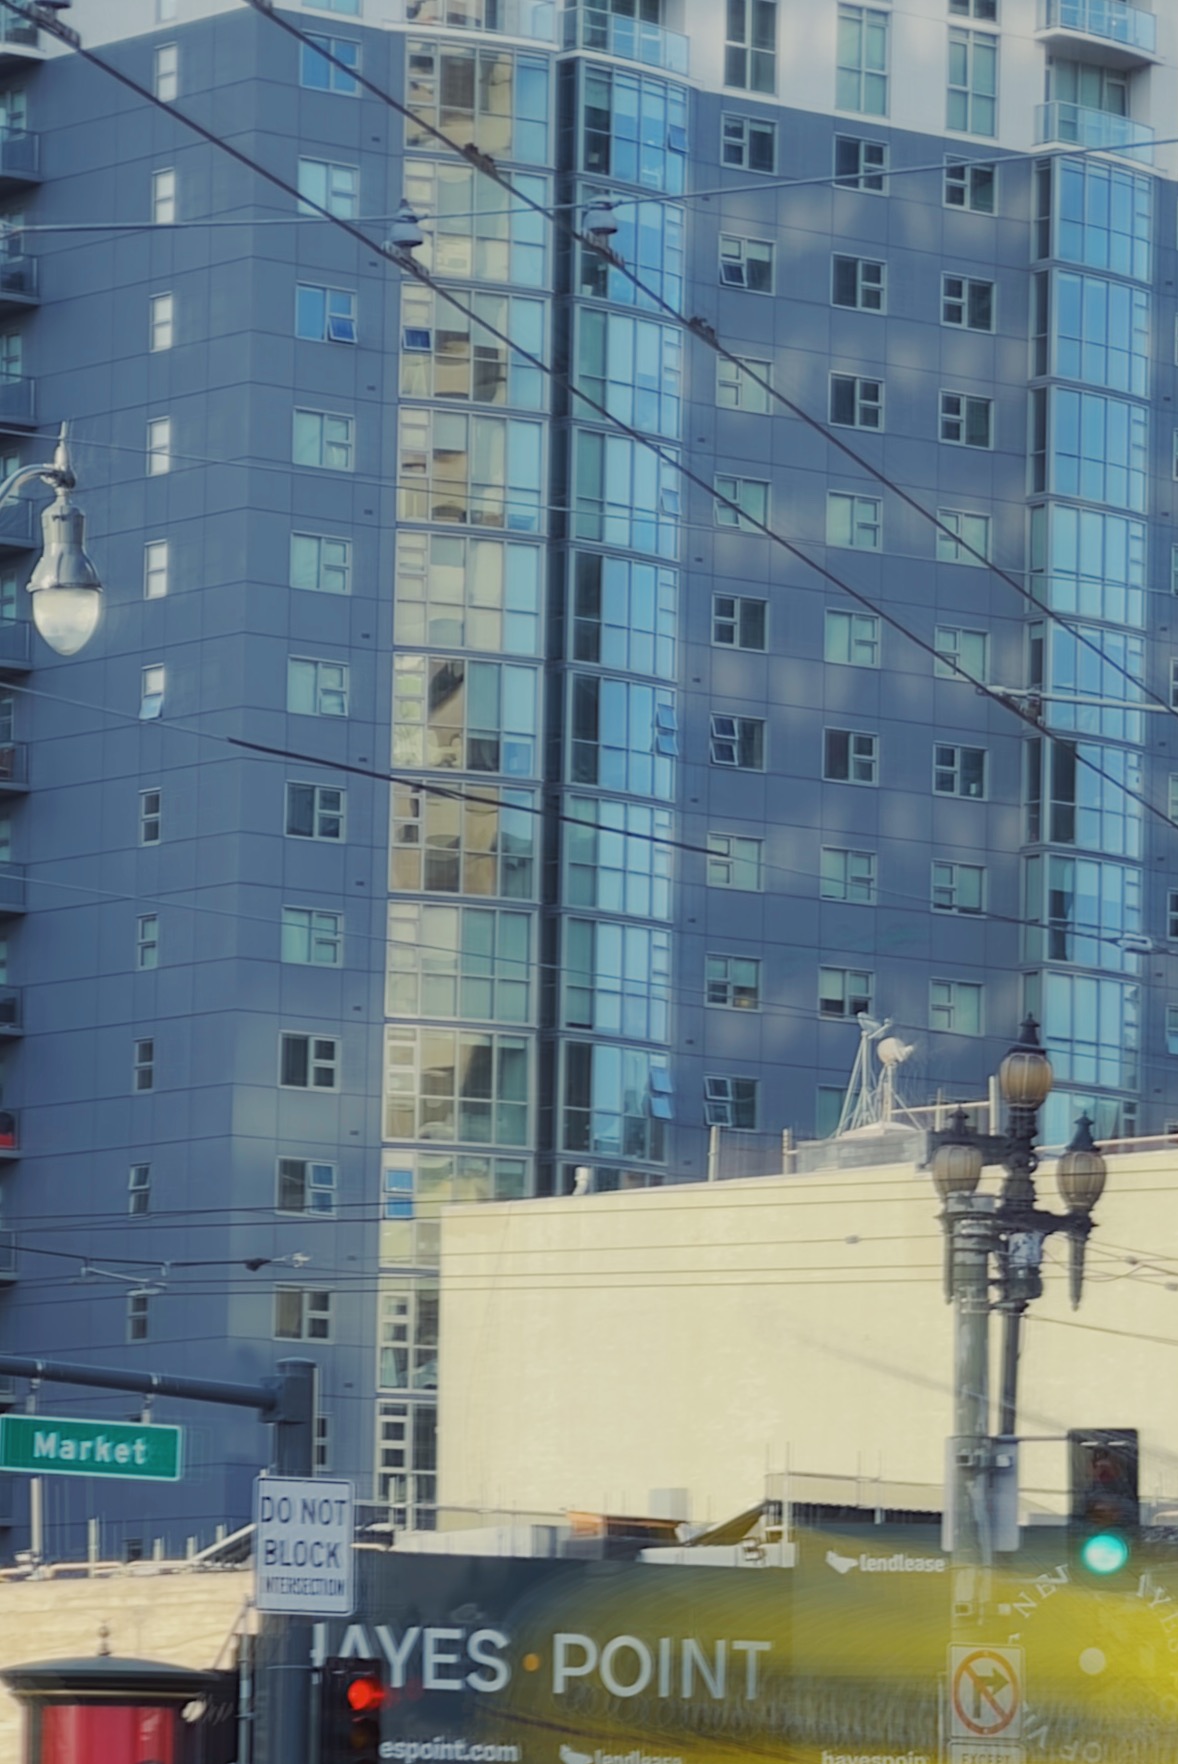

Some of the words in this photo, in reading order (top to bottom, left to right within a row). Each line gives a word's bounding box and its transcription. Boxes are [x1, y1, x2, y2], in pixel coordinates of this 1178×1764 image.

[32, 1430, 148, 1465] Market
[261, 1496, 292, 1524] DO
[300, 1498, 348, 1526] NOT
[264, 1539, 342, 1568] BLOCK
[859, 1553, 945, 1573] lendlease
[262, 1576, 345, 1596] NTERSECTION
[553, 1632, 772, 1700] POINT
